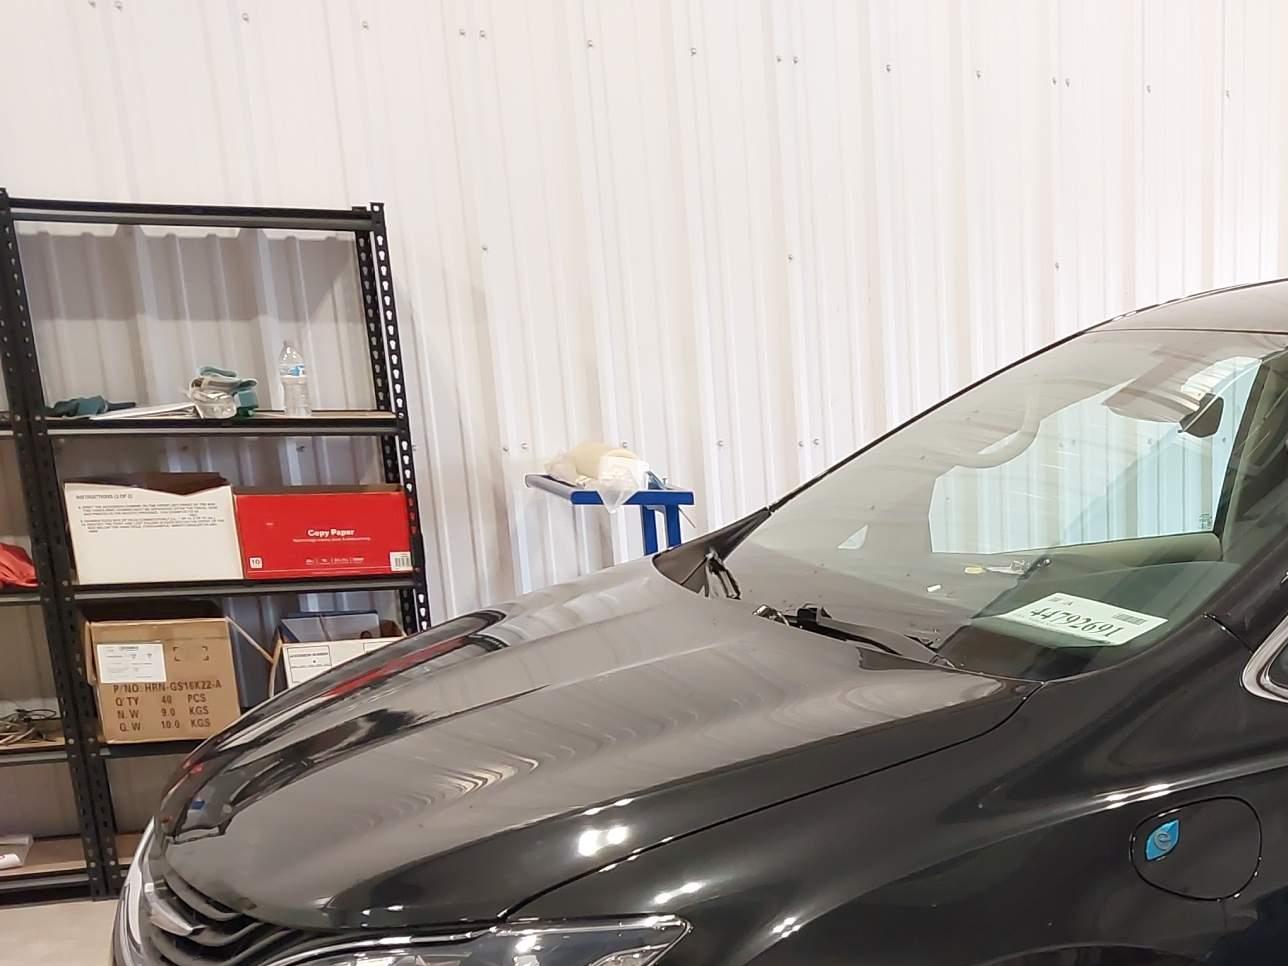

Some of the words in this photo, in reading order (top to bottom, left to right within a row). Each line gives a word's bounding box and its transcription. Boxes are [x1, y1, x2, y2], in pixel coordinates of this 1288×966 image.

[307, 529, 330, 538] Copy
[330, 528, 355, 537] Paper
[251, 558, 261, 567] 10
[1030, 607, 1125, 637] 44792691
[161, 695, 172, 704] 40
[187, 693, 207, 703] PCS
[161, 708, 176, 717] 9.0
[189, 706, 209, 715] KGS
[161, 720, 180, 729] 10.0
[190, 718, 211, 728] KGS
